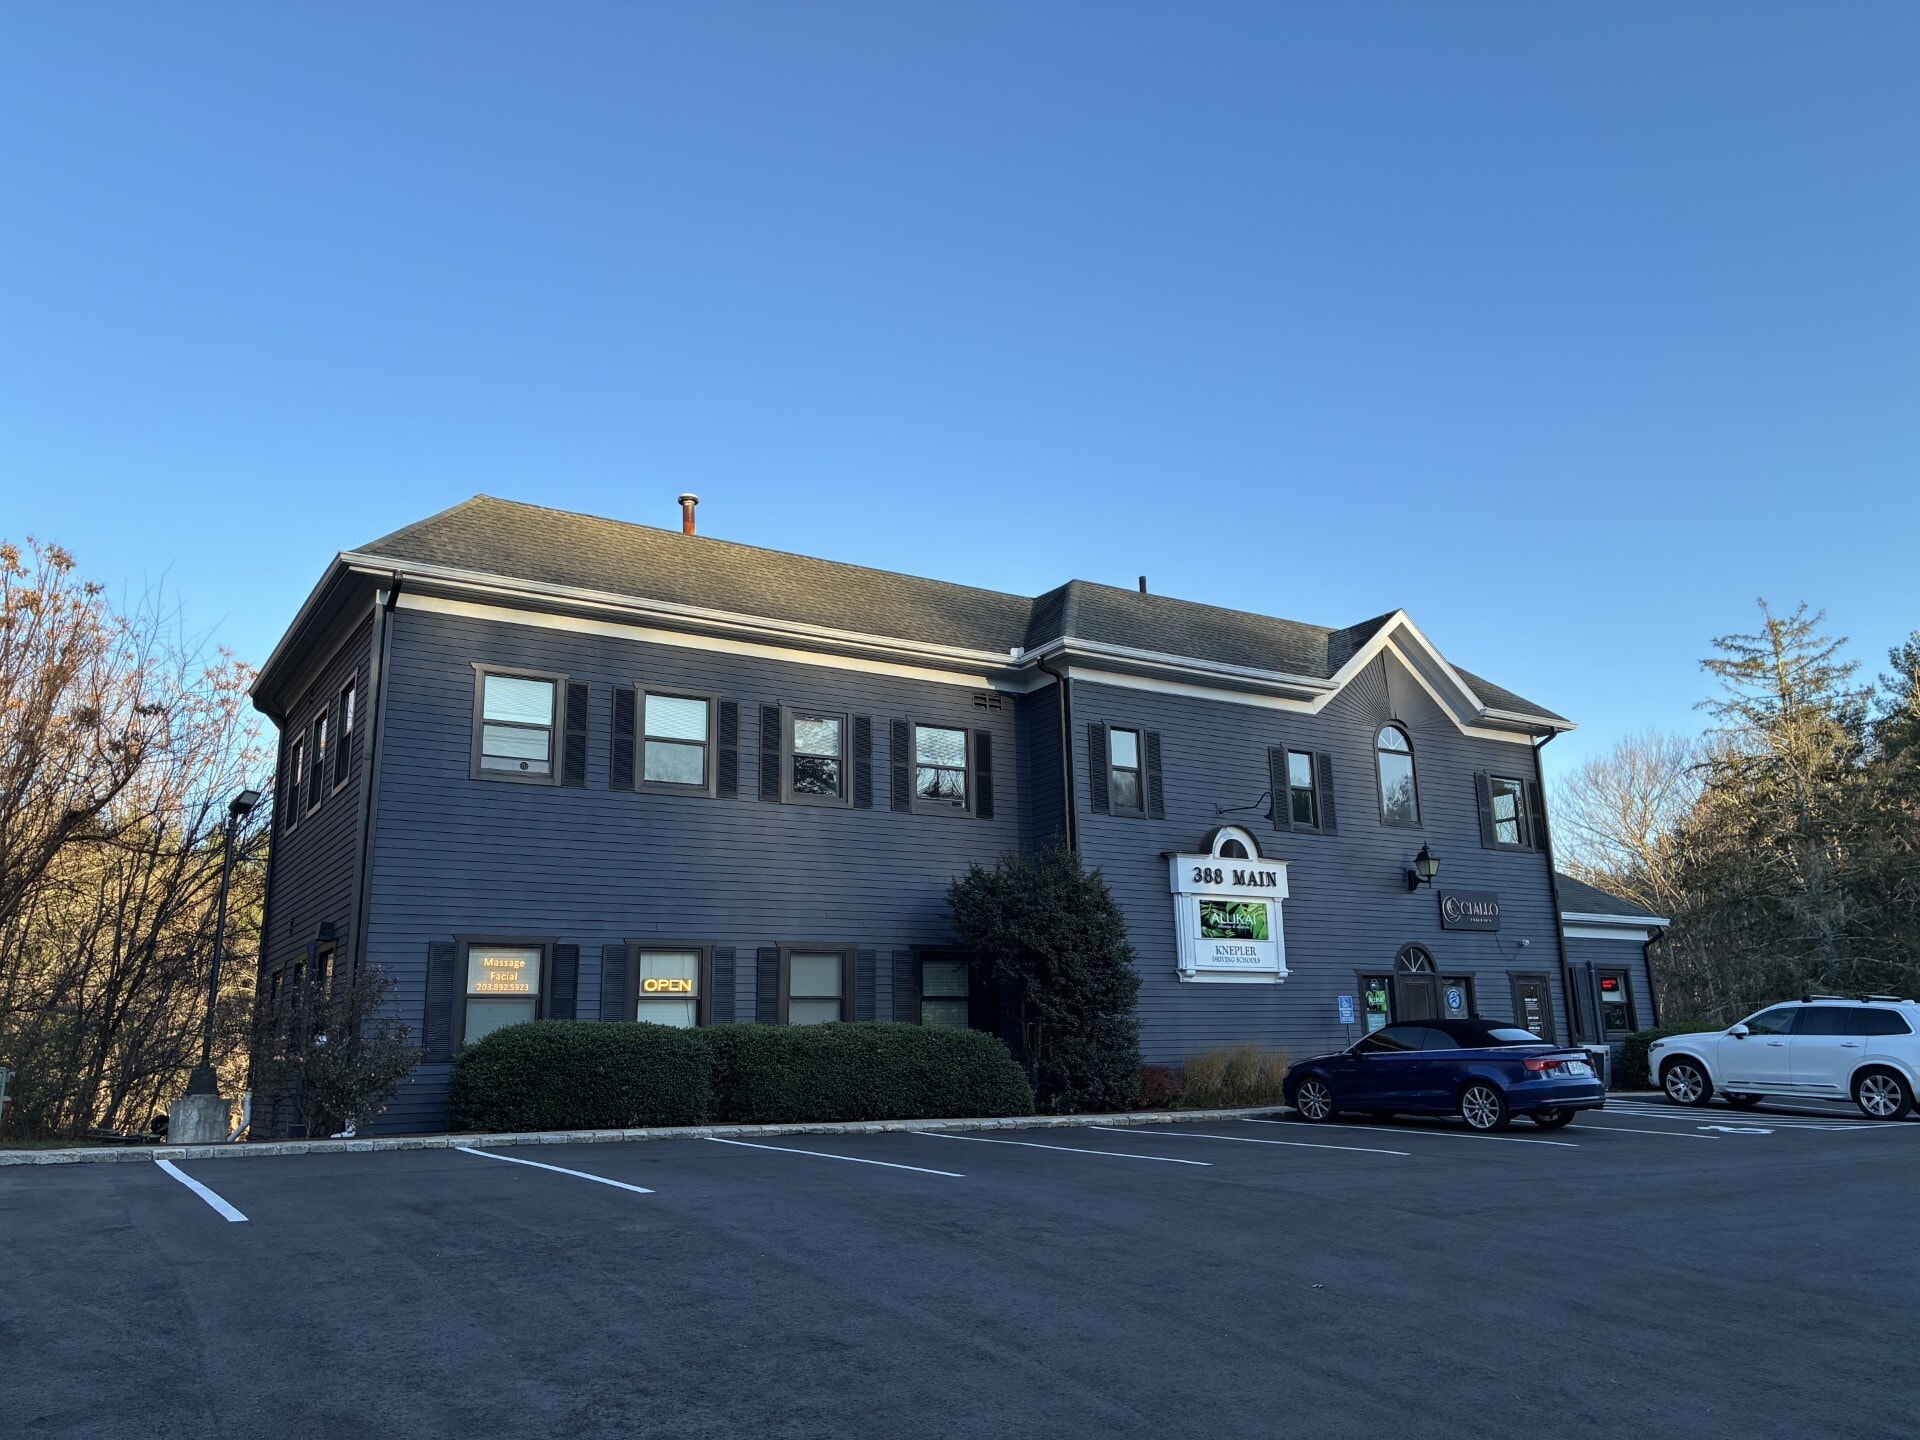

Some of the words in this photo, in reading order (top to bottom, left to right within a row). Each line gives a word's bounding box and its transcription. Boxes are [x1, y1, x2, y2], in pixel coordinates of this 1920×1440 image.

[1193, 867, 1224, 884] 388
[1232, 869, 1277, 887] MAIN
[1215, 945, 1257, 956] KNEPLER
[483, 957, 526, 969] Massage
[1236, 956, 1261, 964] SCHOOLS
[490, 971, 518, 981] Facial
[476, 983, 529, 992] 203.892.5923
[643, 979, 692, 992] OPEN
